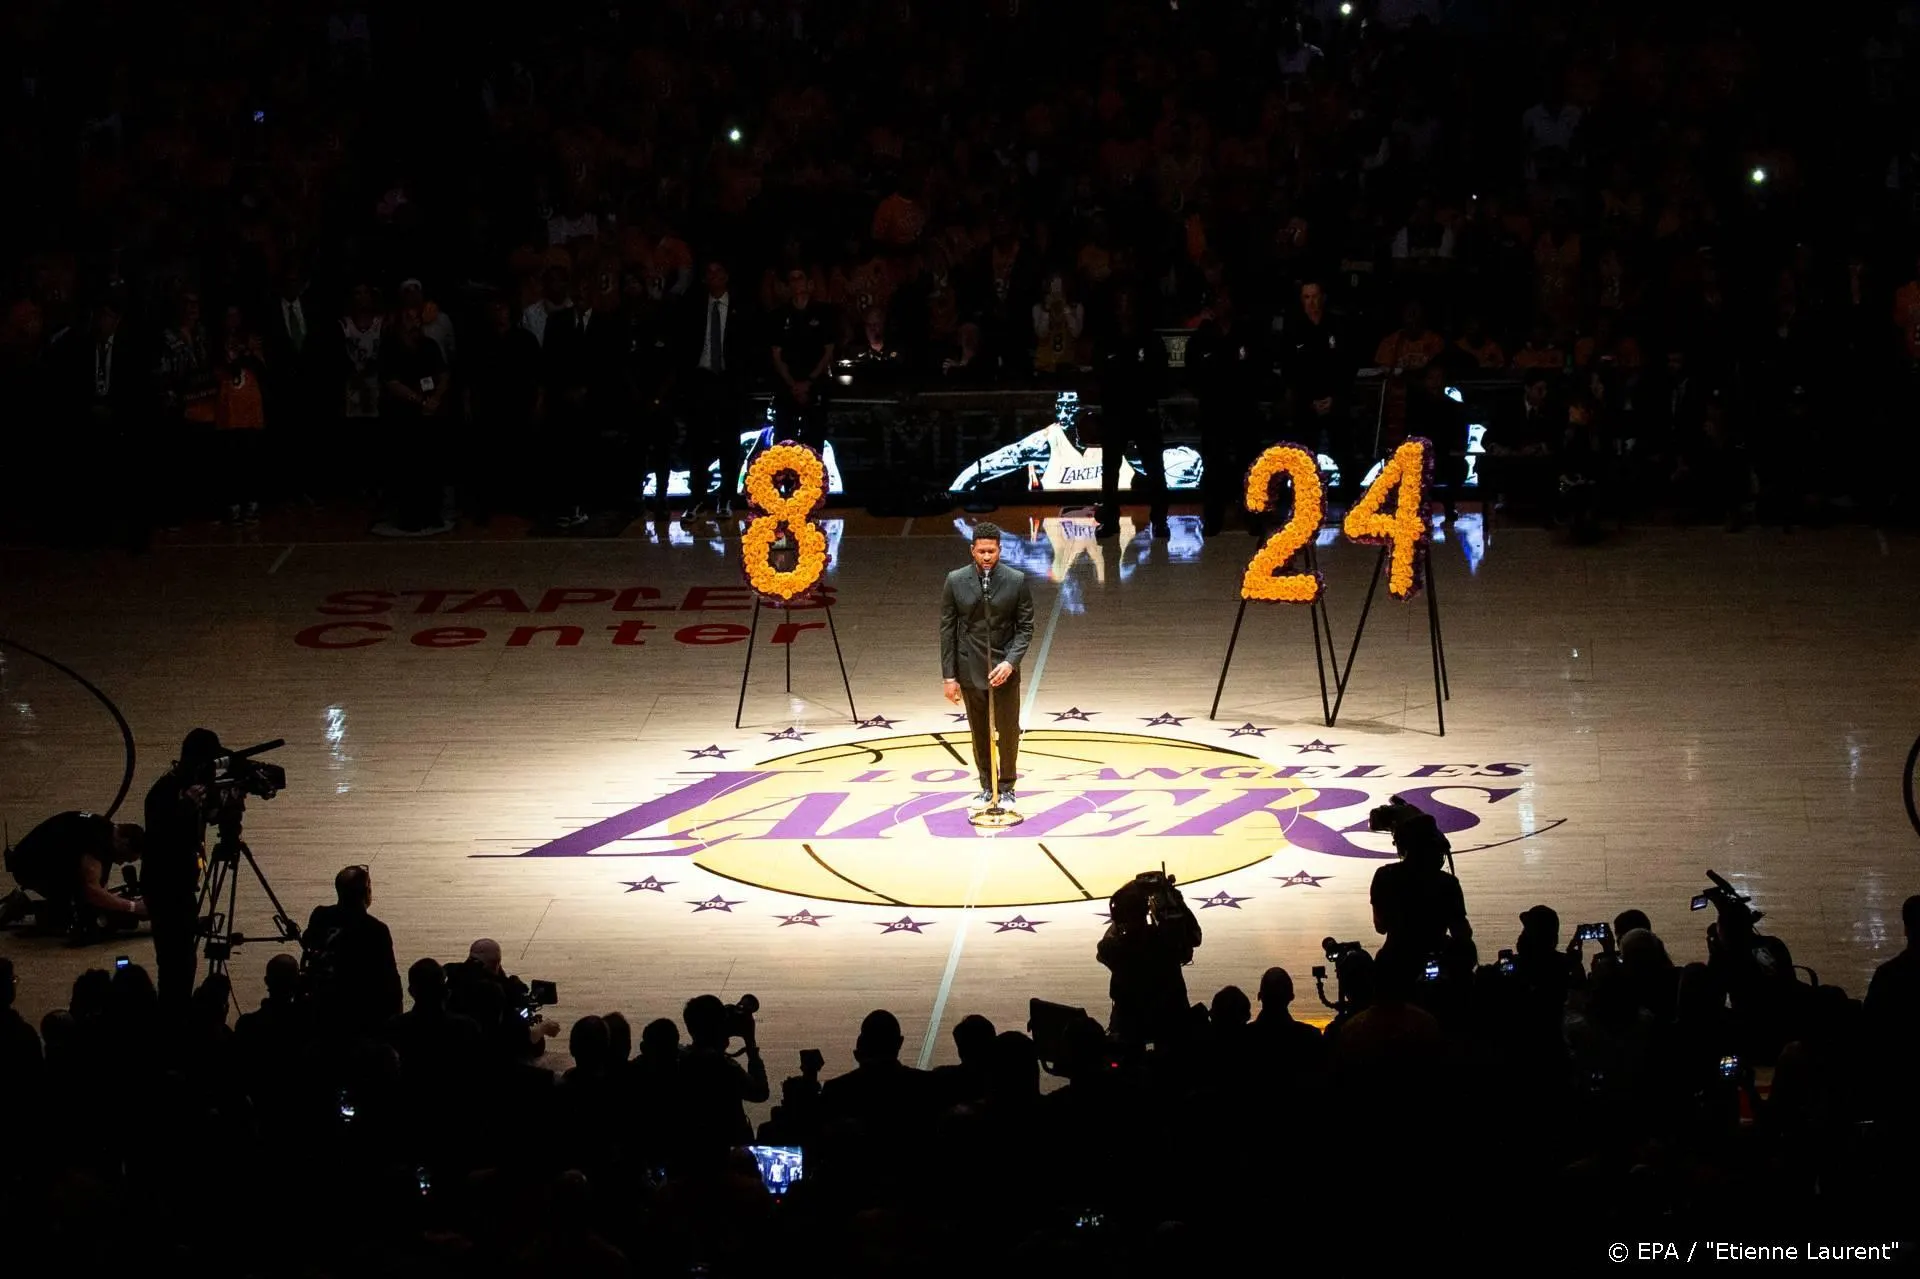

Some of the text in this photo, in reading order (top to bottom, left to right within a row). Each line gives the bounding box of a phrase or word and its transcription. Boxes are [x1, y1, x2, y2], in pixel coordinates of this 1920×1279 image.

[742, 440, 828, 601] 8
[1239, 435, 1434, 602] 24
[294, 620, 826, 649] Center
[505, 770, 1522, 859] LAKERS
[1044, 763, 1531, 781] ANGELES
